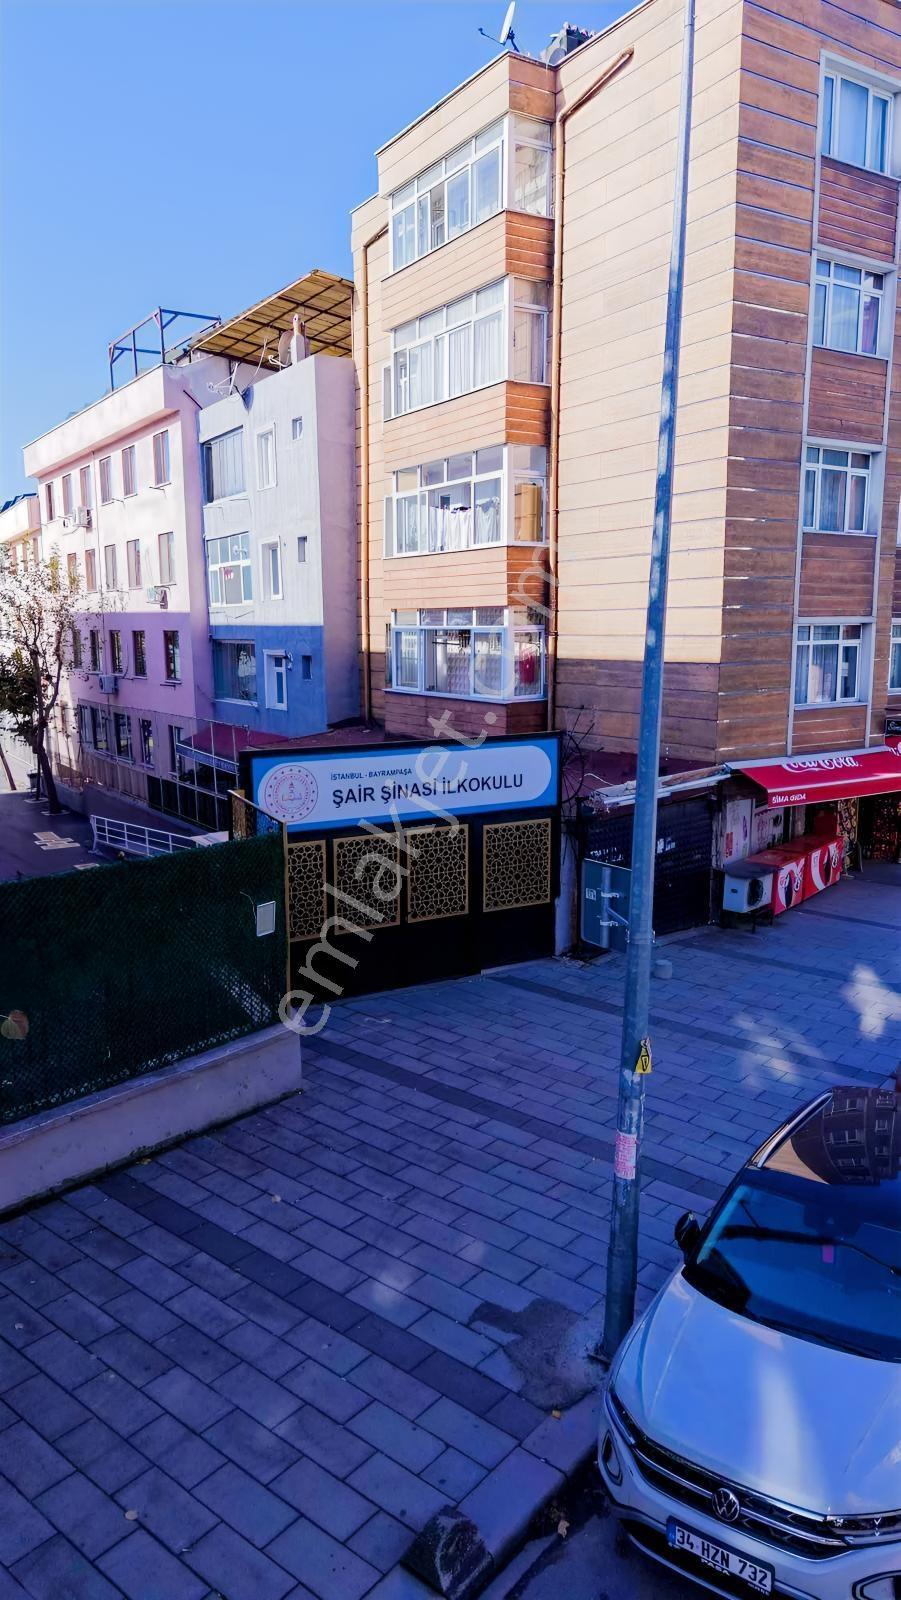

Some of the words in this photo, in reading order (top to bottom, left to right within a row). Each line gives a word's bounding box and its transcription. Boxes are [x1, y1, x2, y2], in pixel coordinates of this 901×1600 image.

[330, 769, 365, 781] İSTANBUL
[368, 767, 413, 779] BAYRAMPAŞA
[332, 783, 376, 808] ŞAİR
[380, 777, 438, 805] ŞİNASİ
[442, 773, 524, 795] İLKOKULU
[676, 1528, 695, 1550] 34
[701, 1540, 730, 1570] HZN
[738, 1558, 768, 1588] 732
